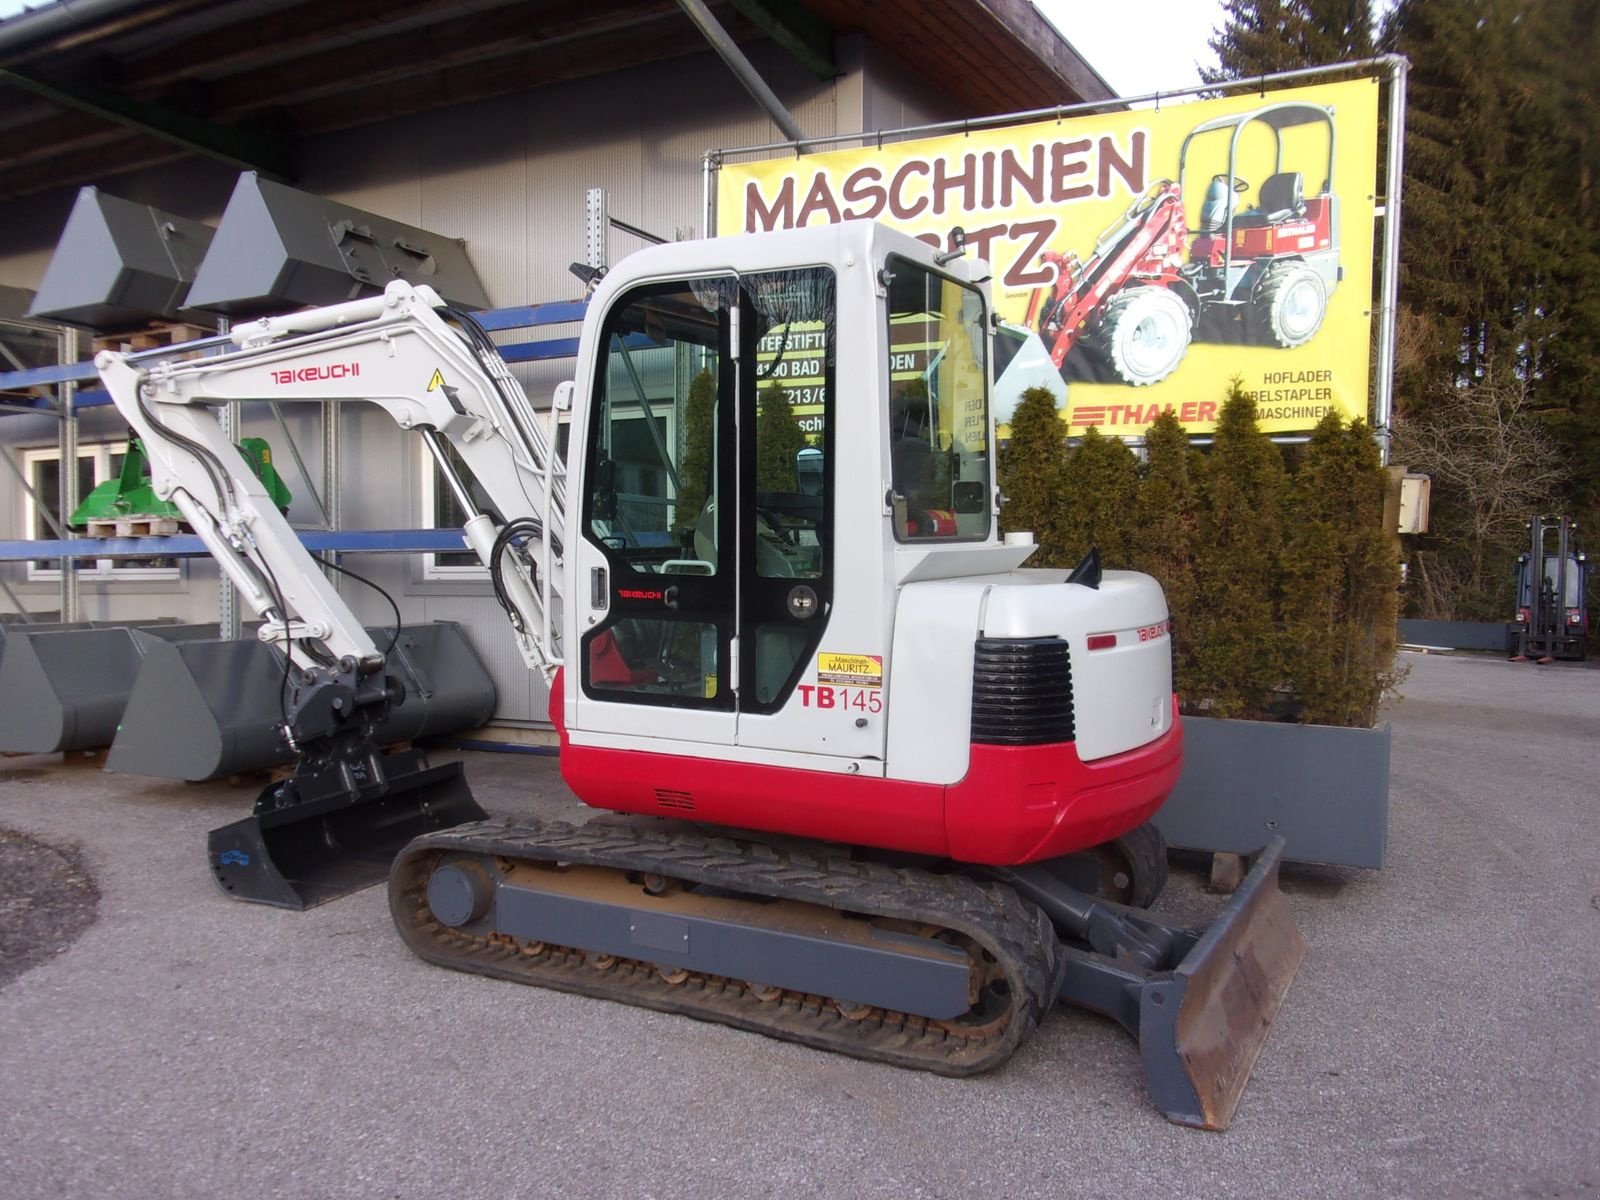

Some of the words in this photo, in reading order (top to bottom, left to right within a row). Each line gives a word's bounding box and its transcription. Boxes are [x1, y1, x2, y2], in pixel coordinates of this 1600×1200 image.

[746, 131, 1145, 233] MASCHINEN
[791, 360, 820, 376] BAD
[1264, 370, 1332, 384] HOFLADER
[828, 663, 870, 674] MAURITZ
